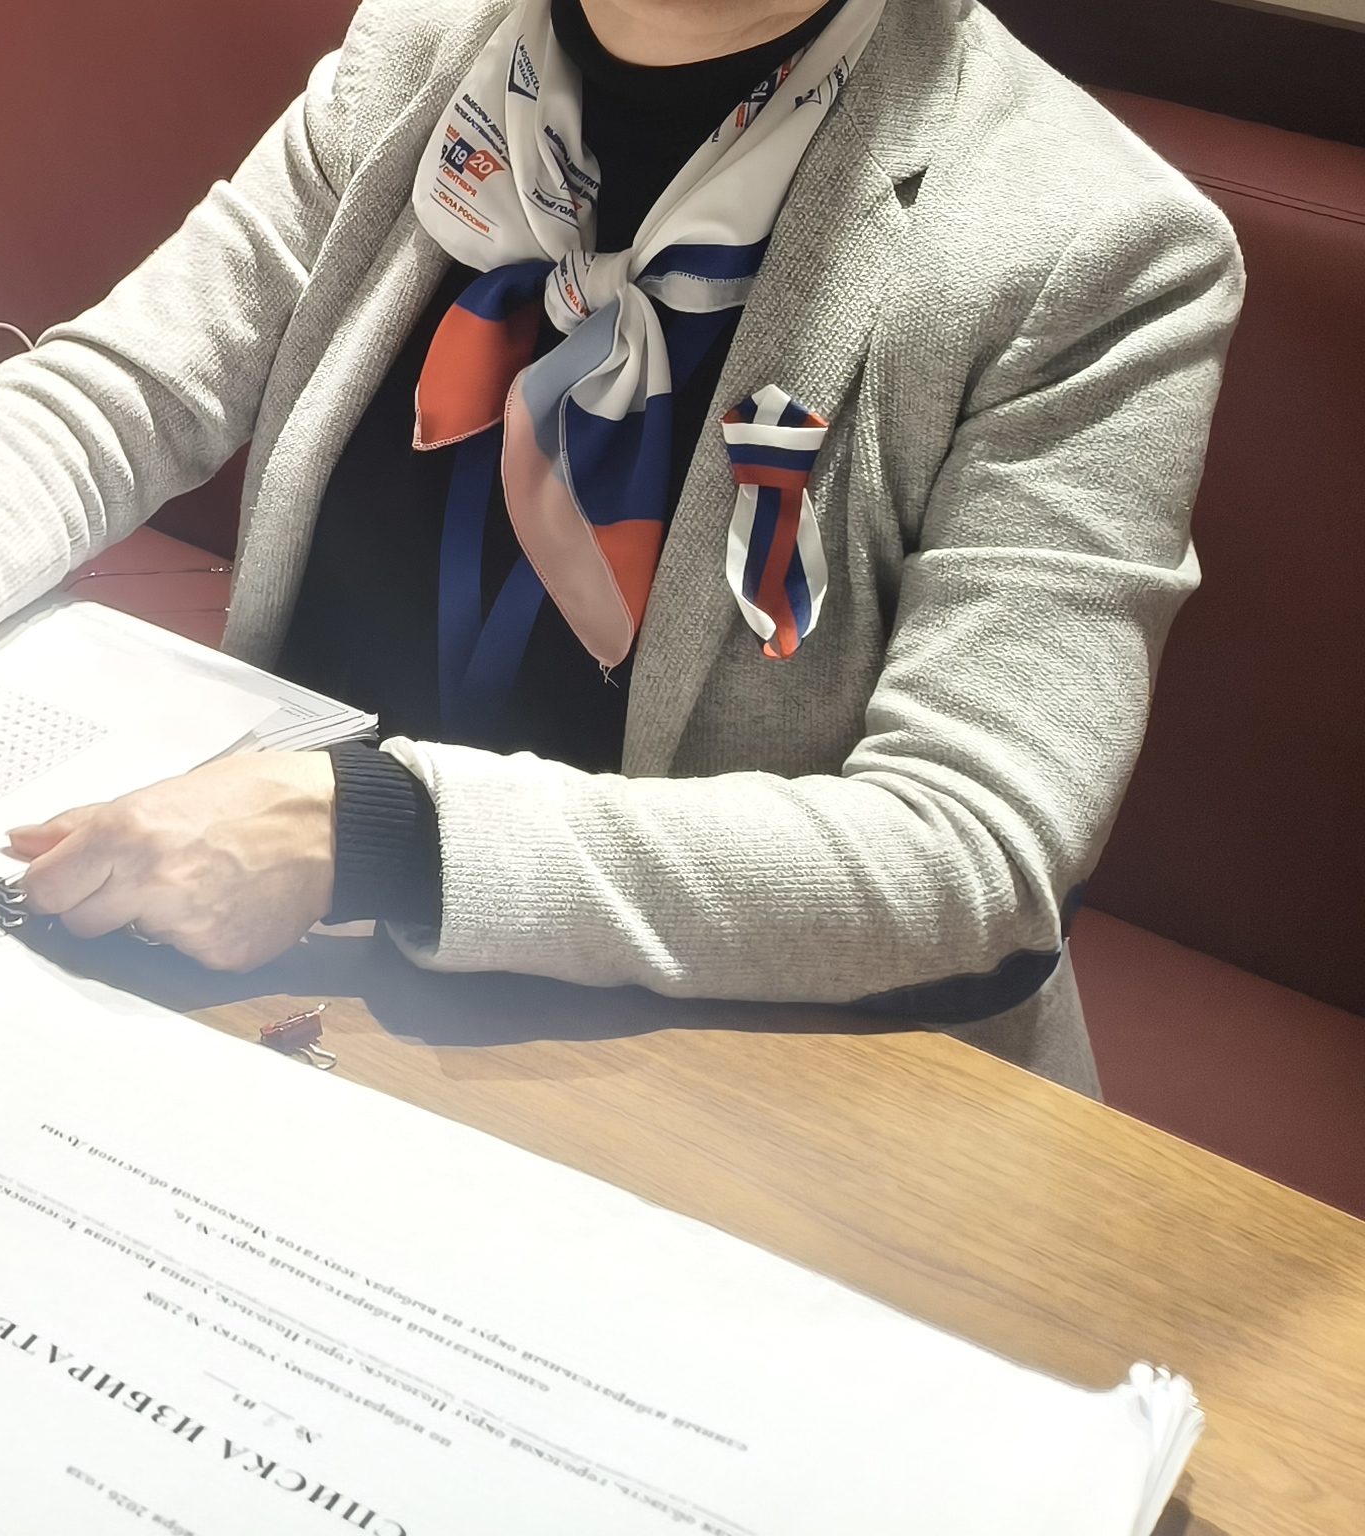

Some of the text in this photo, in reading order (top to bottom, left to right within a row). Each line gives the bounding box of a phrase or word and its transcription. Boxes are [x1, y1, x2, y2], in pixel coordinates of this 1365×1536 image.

[450, 144, 494, 174] 19 20
[223, 1438, 407, 1536] СПИСКА
